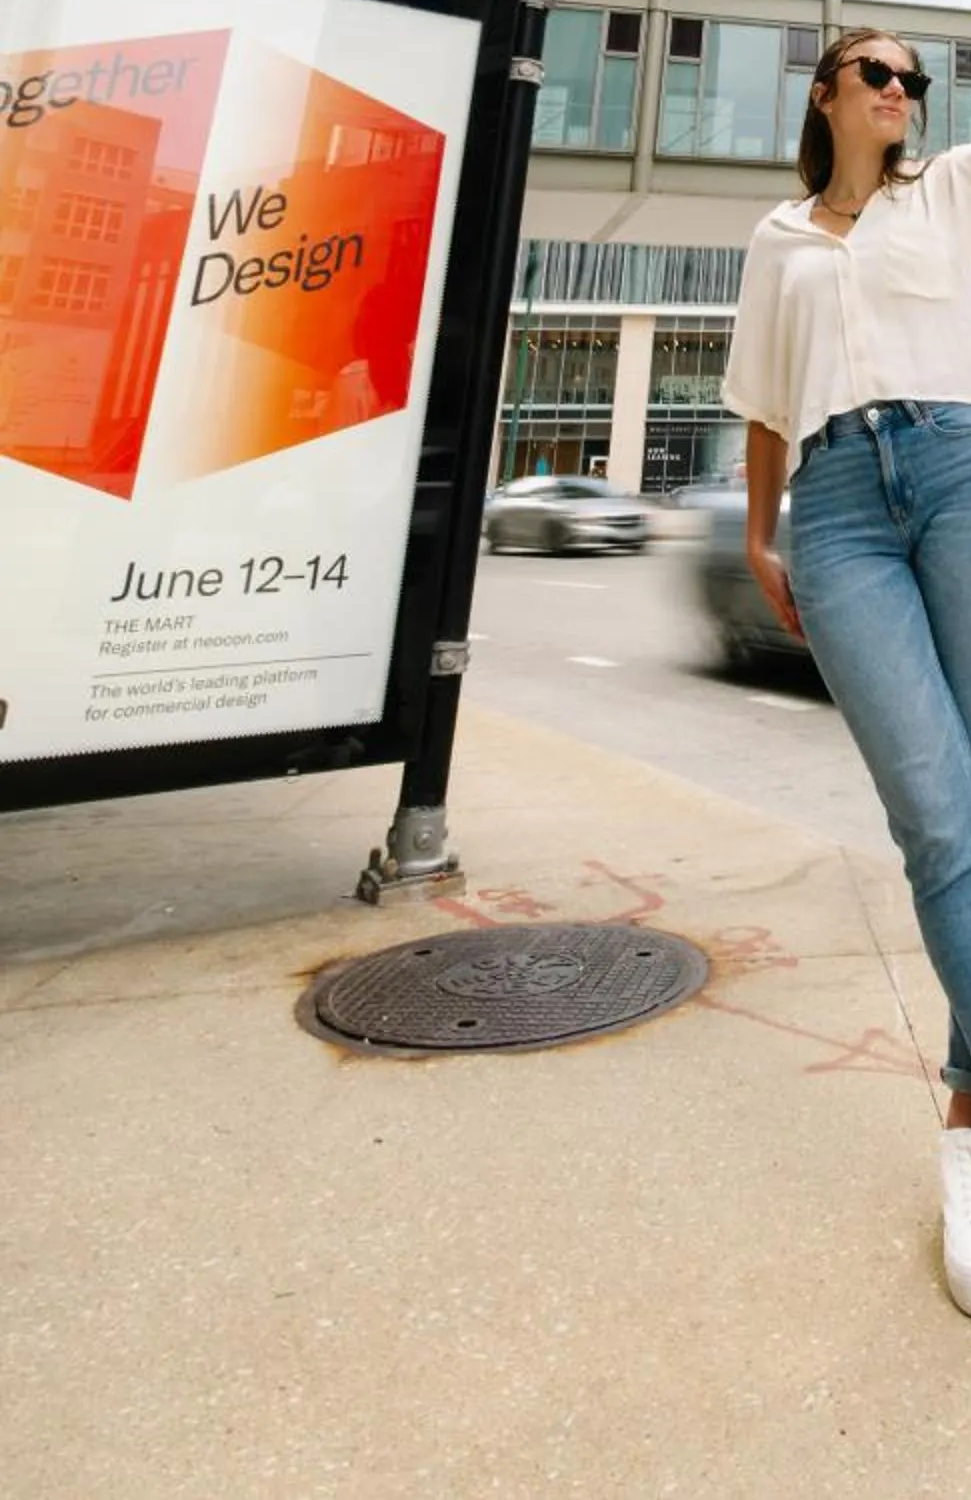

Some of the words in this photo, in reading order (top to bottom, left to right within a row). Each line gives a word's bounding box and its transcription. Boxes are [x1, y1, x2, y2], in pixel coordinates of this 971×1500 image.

[207, 184, 288, 241] We
[190, 233, 364, 307] Design
[110, 561, 224, 602] June
[104, 619, 140, 634] THE
[144, 615, 196, 633] MART
[99, 639, 168, 657] Register
[173, 636, 189, 650] at
[193, 630, 290, 649] neocon.com
[90, 684, 122, 699] The
[190, 671, 249, 691] leading
[253, 667, 318, 687] platform
[84, 705, 109, 722] for
[113, 696, 211, 720] commercial
[215, 691, 268, 710] design
